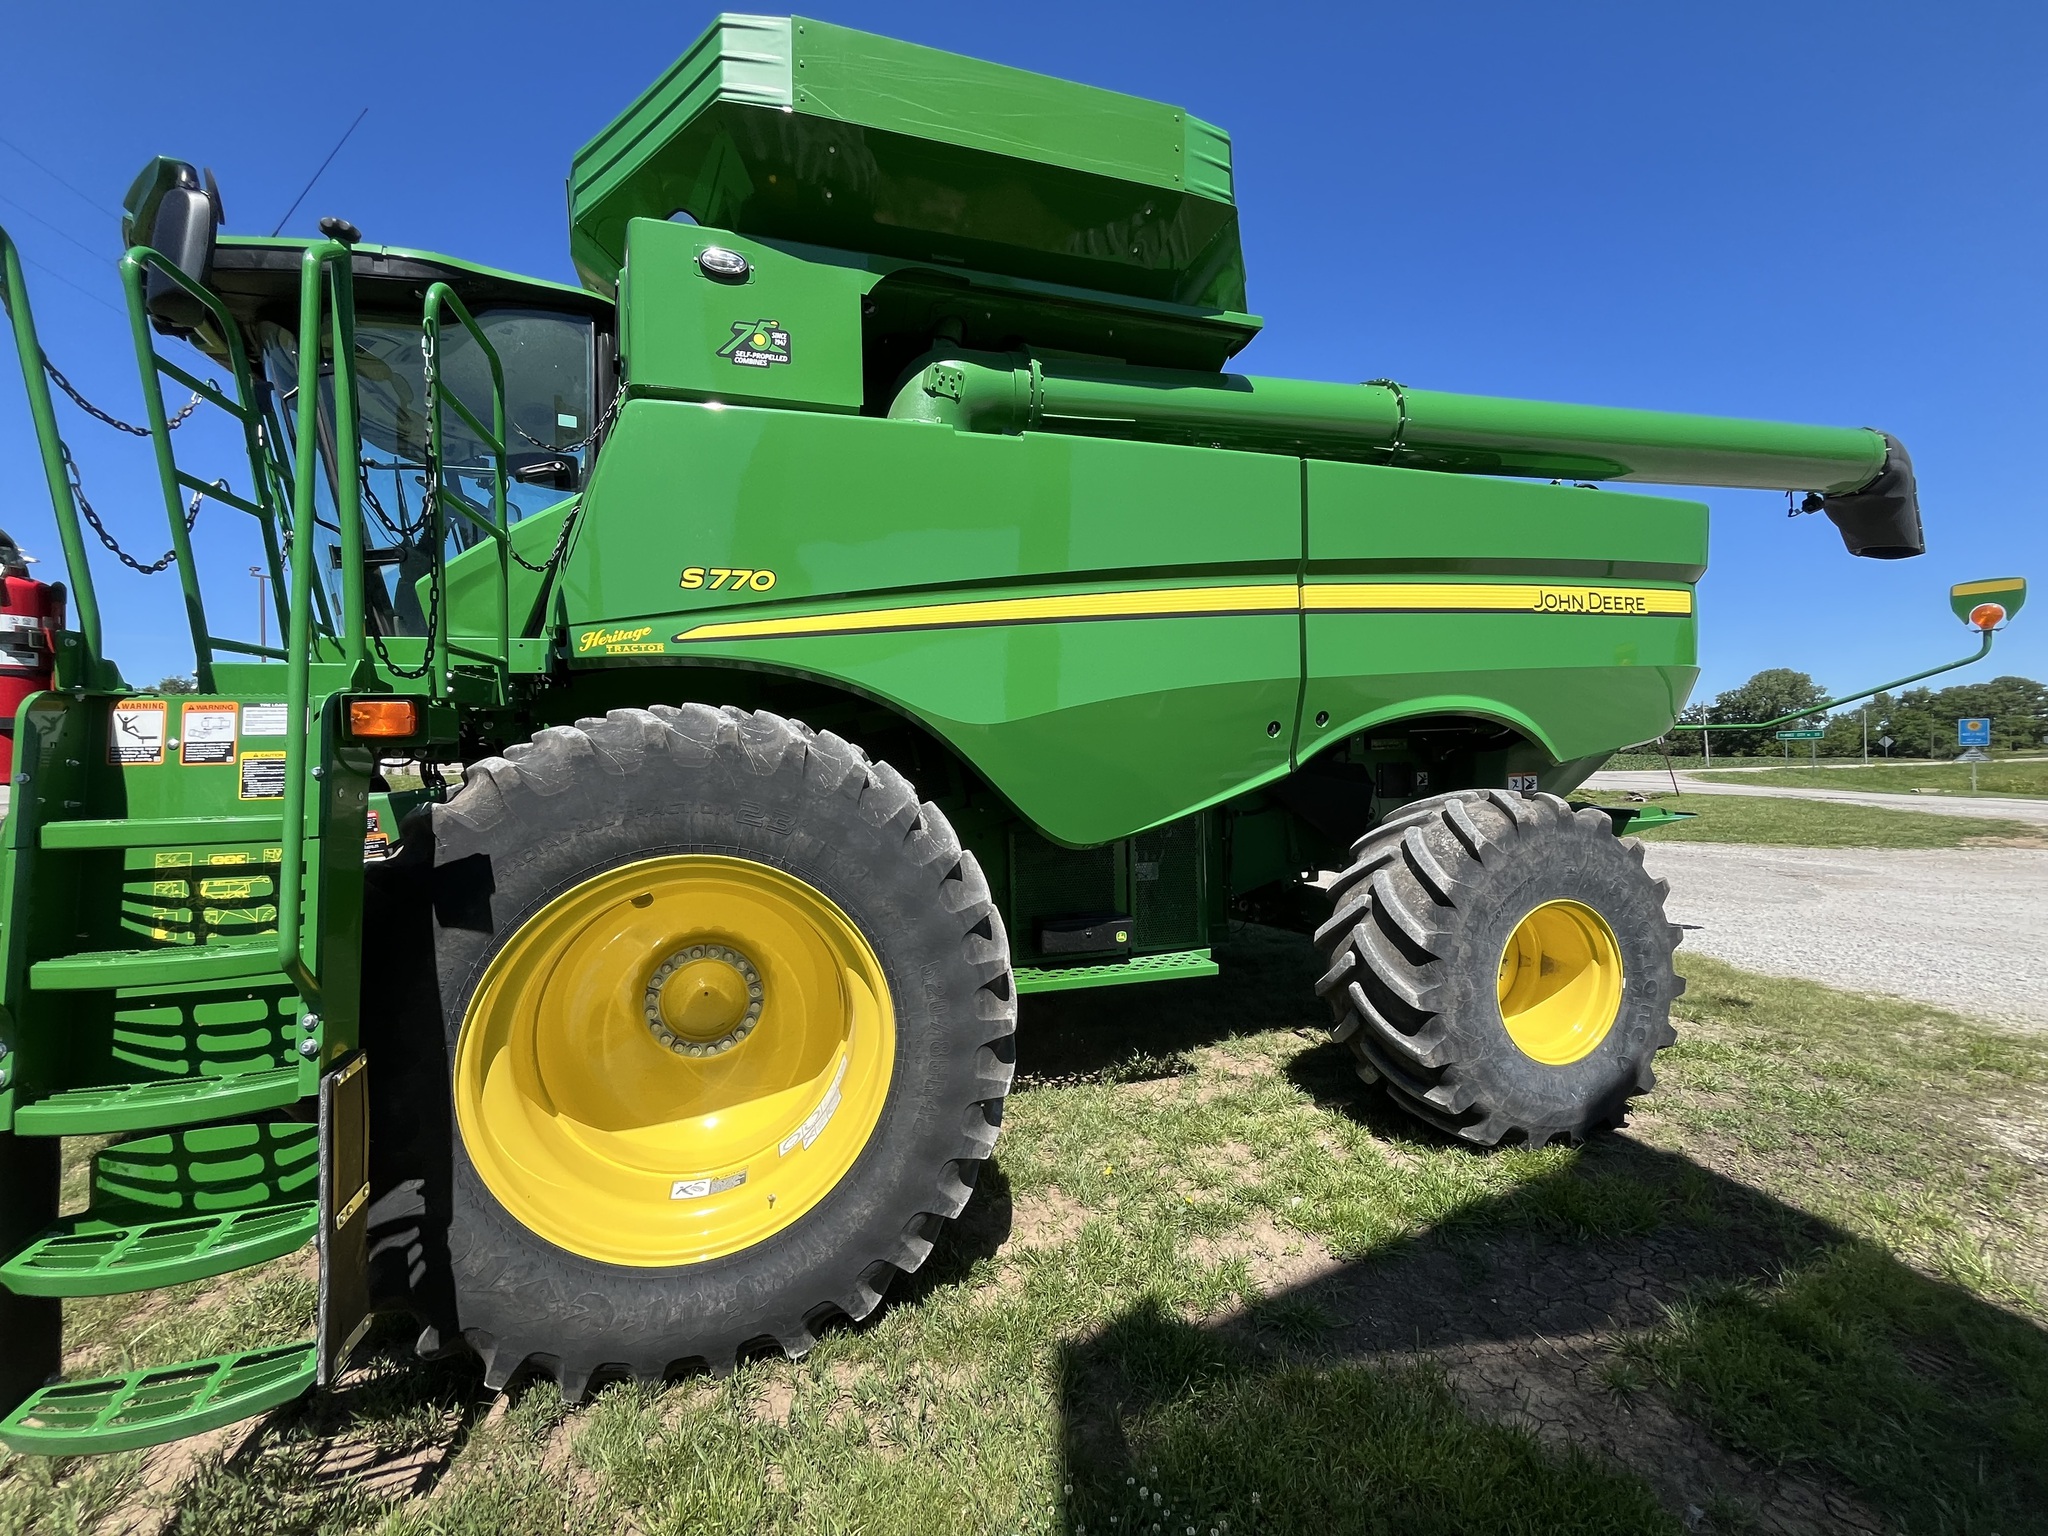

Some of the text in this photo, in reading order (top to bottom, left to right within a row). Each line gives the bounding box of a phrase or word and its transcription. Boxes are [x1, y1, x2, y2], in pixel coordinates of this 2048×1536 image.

[720, 320, 777, 355] 75
[734, 356, 768, 366] COMBINES
[735, 350, 788, 362] SELF-PROPELLED
[679, 566, 777, 592] S770
[1533, 590, 1646, 611] JOHN DEERE
[579, 625, 652, 652] Heritage
[606, 643, 664, 653] TRACTOR
[121, 702, 164, 710] WARNING
